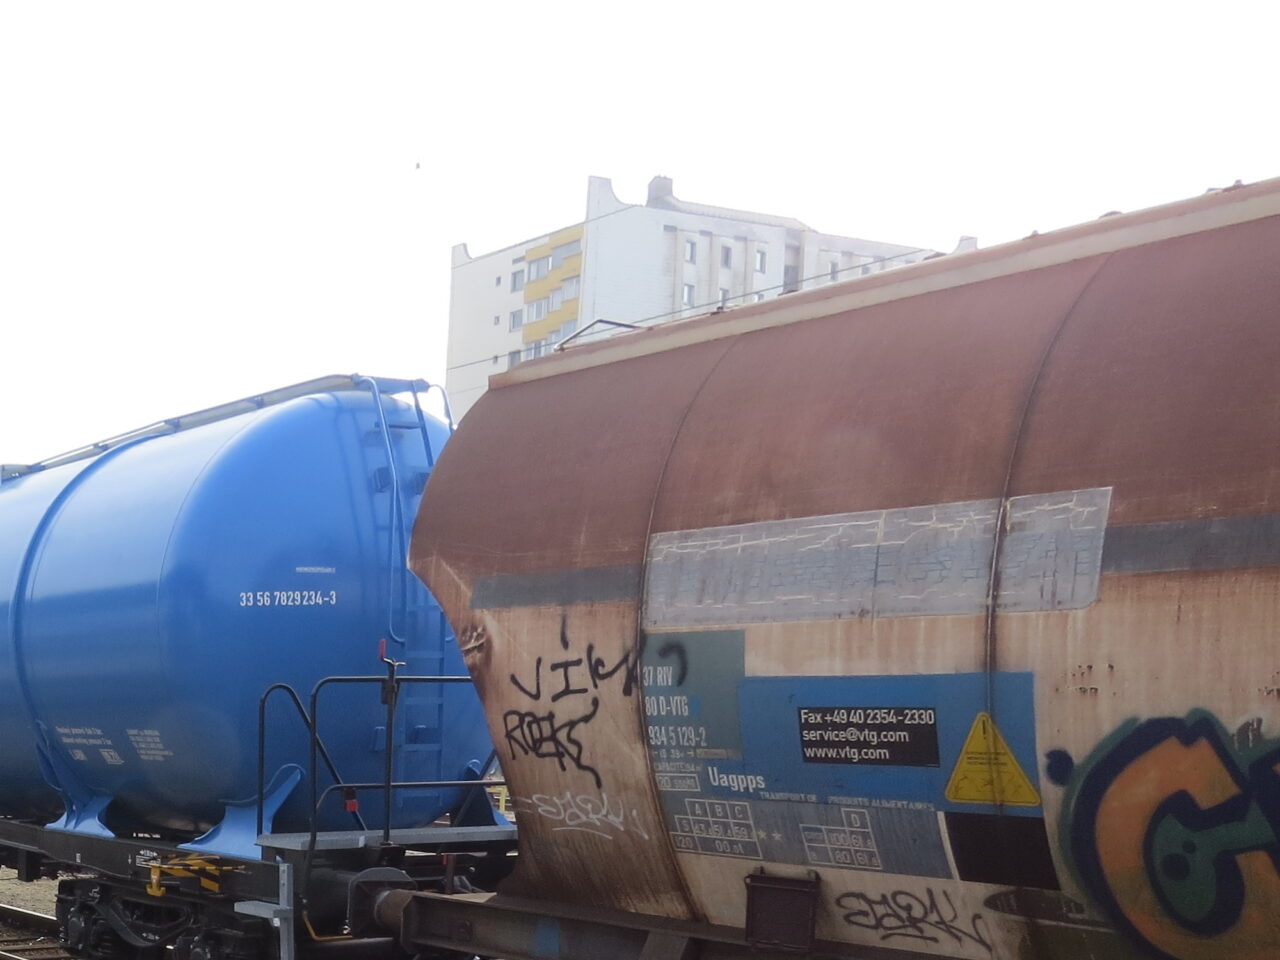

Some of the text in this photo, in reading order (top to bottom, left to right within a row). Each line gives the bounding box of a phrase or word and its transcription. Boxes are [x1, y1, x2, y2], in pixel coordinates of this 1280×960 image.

[240, 592, 254, 606] 33
[257, 592, 271, 606] 56
[642, 665, 673, 686] 37 RIV
[644, 695, 689, 716] 80 D-VTG
[800, 709, 936, 725] Fax +49 40 2354-2330
[802, 727, 909, 745] service@vtg.com
[804, 746, 890, 762] www.vtg.com
[707, 766, 766, 792] Uagpps
